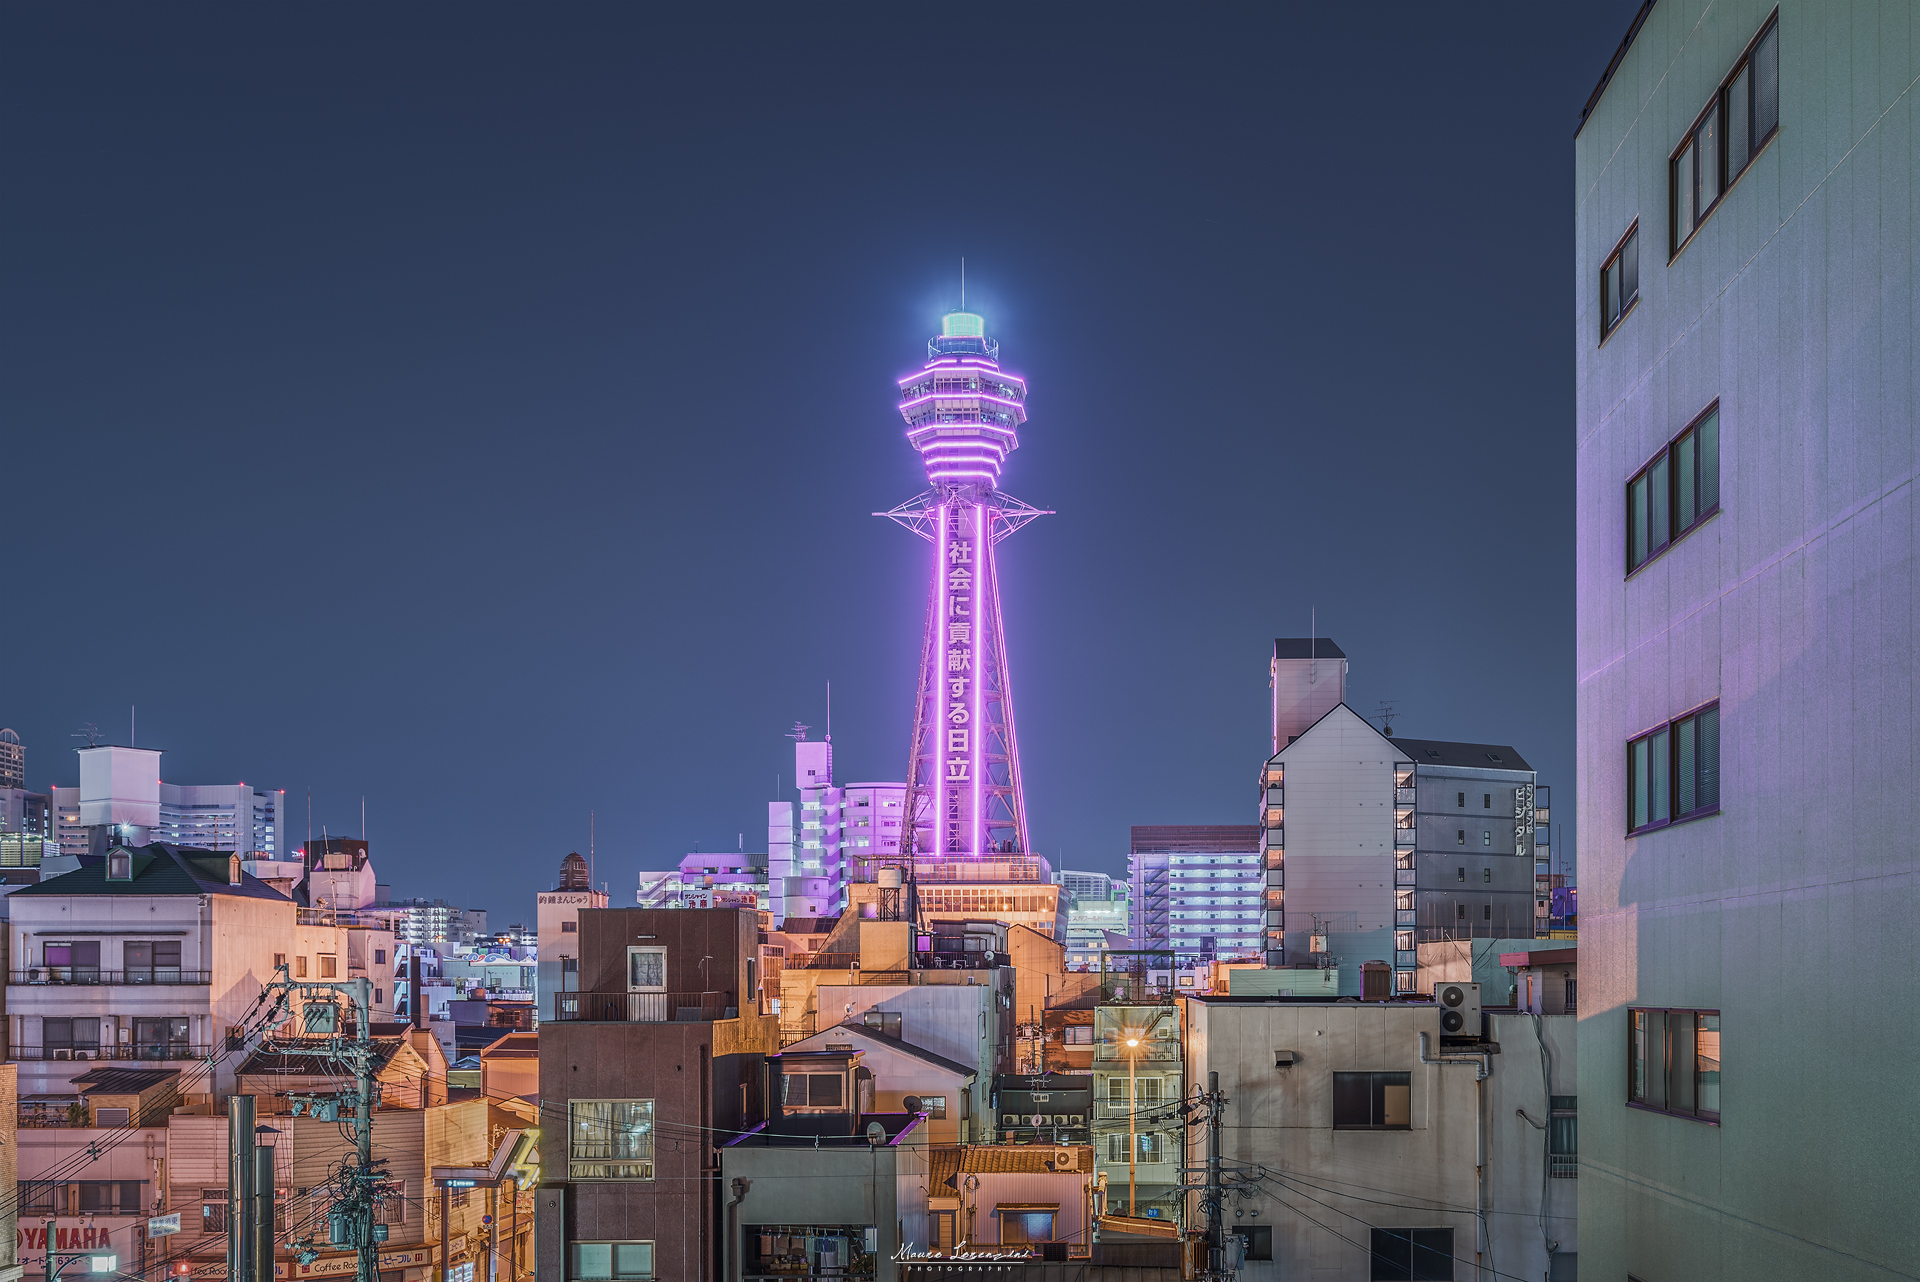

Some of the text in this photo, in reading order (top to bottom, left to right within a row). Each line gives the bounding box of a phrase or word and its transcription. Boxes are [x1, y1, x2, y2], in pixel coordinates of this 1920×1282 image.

[946, 541, 972, 782] 社会に貢献する日立
[24, 1228, 111, 1249] YAMAHA
[314, 1263, 341, 1273] Coffee
[343, 1261, 358, 1270] Roo
